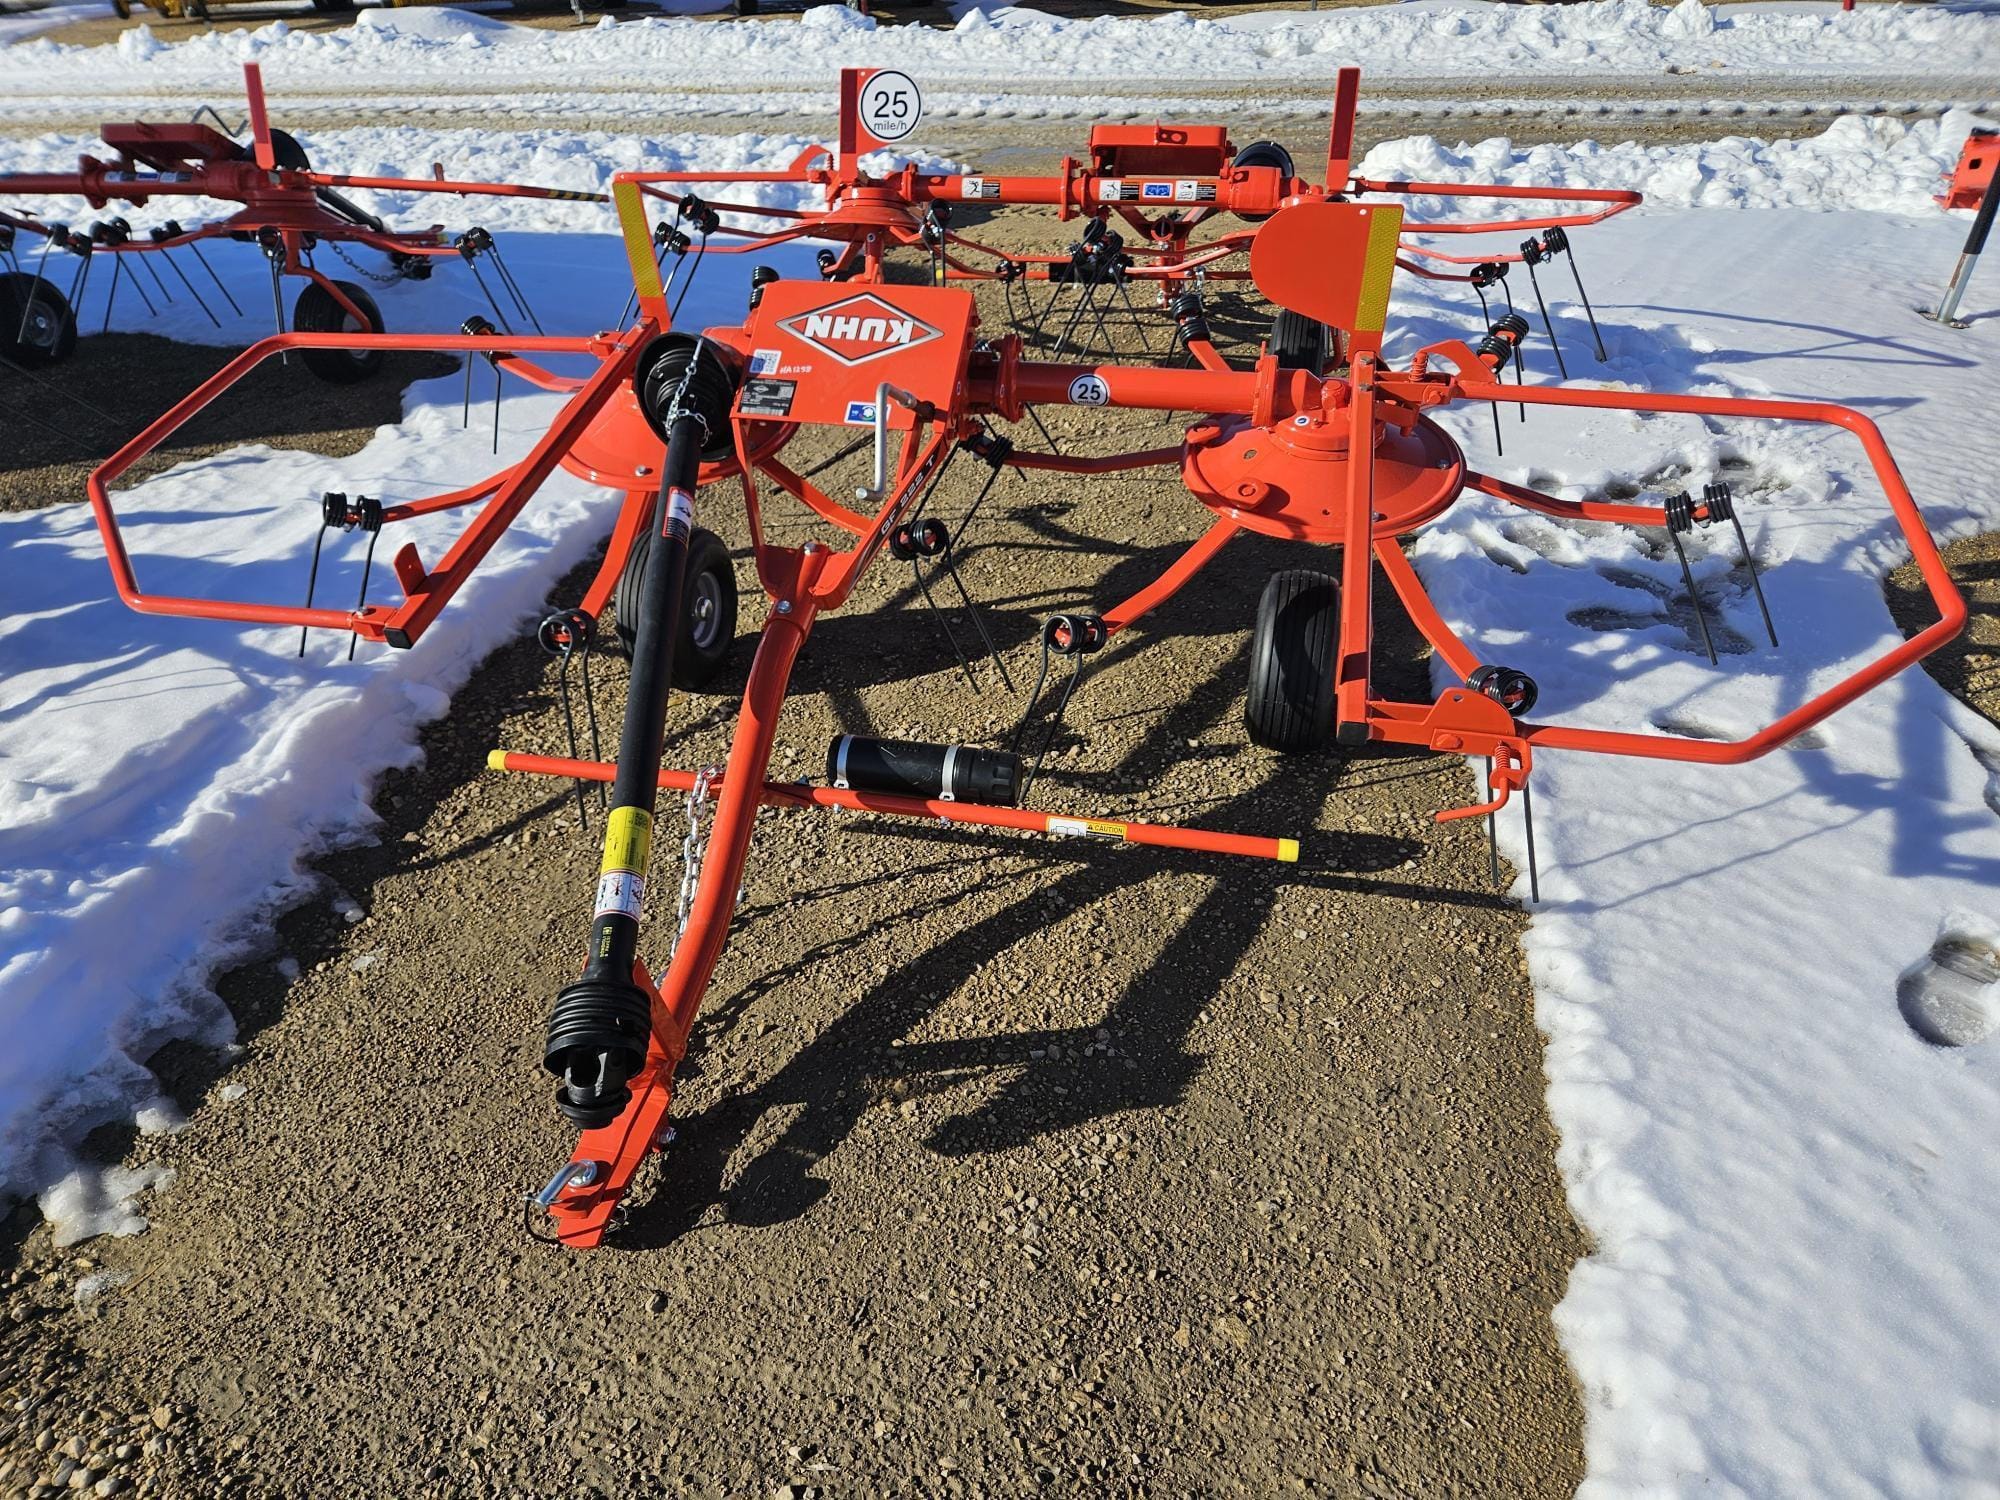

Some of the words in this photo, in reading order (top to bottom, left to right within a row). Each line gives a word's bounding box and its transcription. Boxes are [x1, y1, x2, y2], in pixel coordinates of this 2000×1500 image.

[874, 91, 908, 118] 25
[874, 121, 908, 131] mile/h
[804, 315, 915, 343] KUHN
[1077, 383, 1101, 400] 25
[881, 508, 897, 535] GF
[925, 454, 936, 467] T
[1095, 824, 1123, 834] CAUTION
